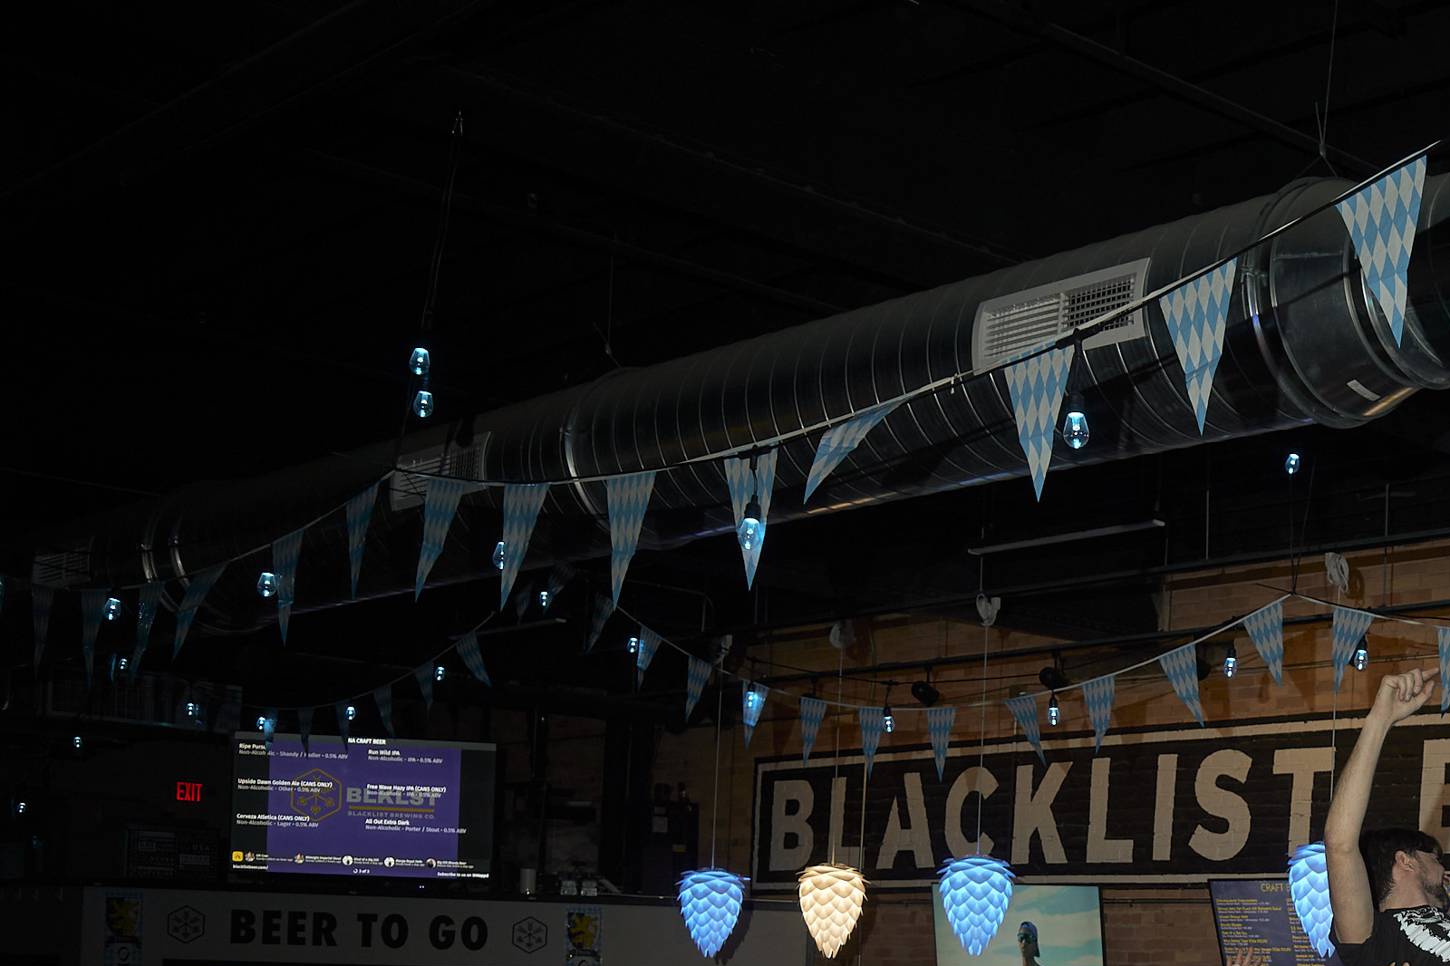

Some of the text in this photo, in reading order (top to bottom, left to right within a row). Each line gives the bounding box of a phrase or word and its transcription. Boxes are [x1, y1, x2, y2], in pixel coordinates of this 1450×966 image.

[238, 778, 256, 786] Upside
[176, 782, 203, 802] EXIT
[347, 810, 388, 818] BLACKLIST
[769, 746, 1336, 872] BLACKLIST
[1260, 882, 1283, 893] CRAFT
[230, 909, 489, 951] BEER TO GO
